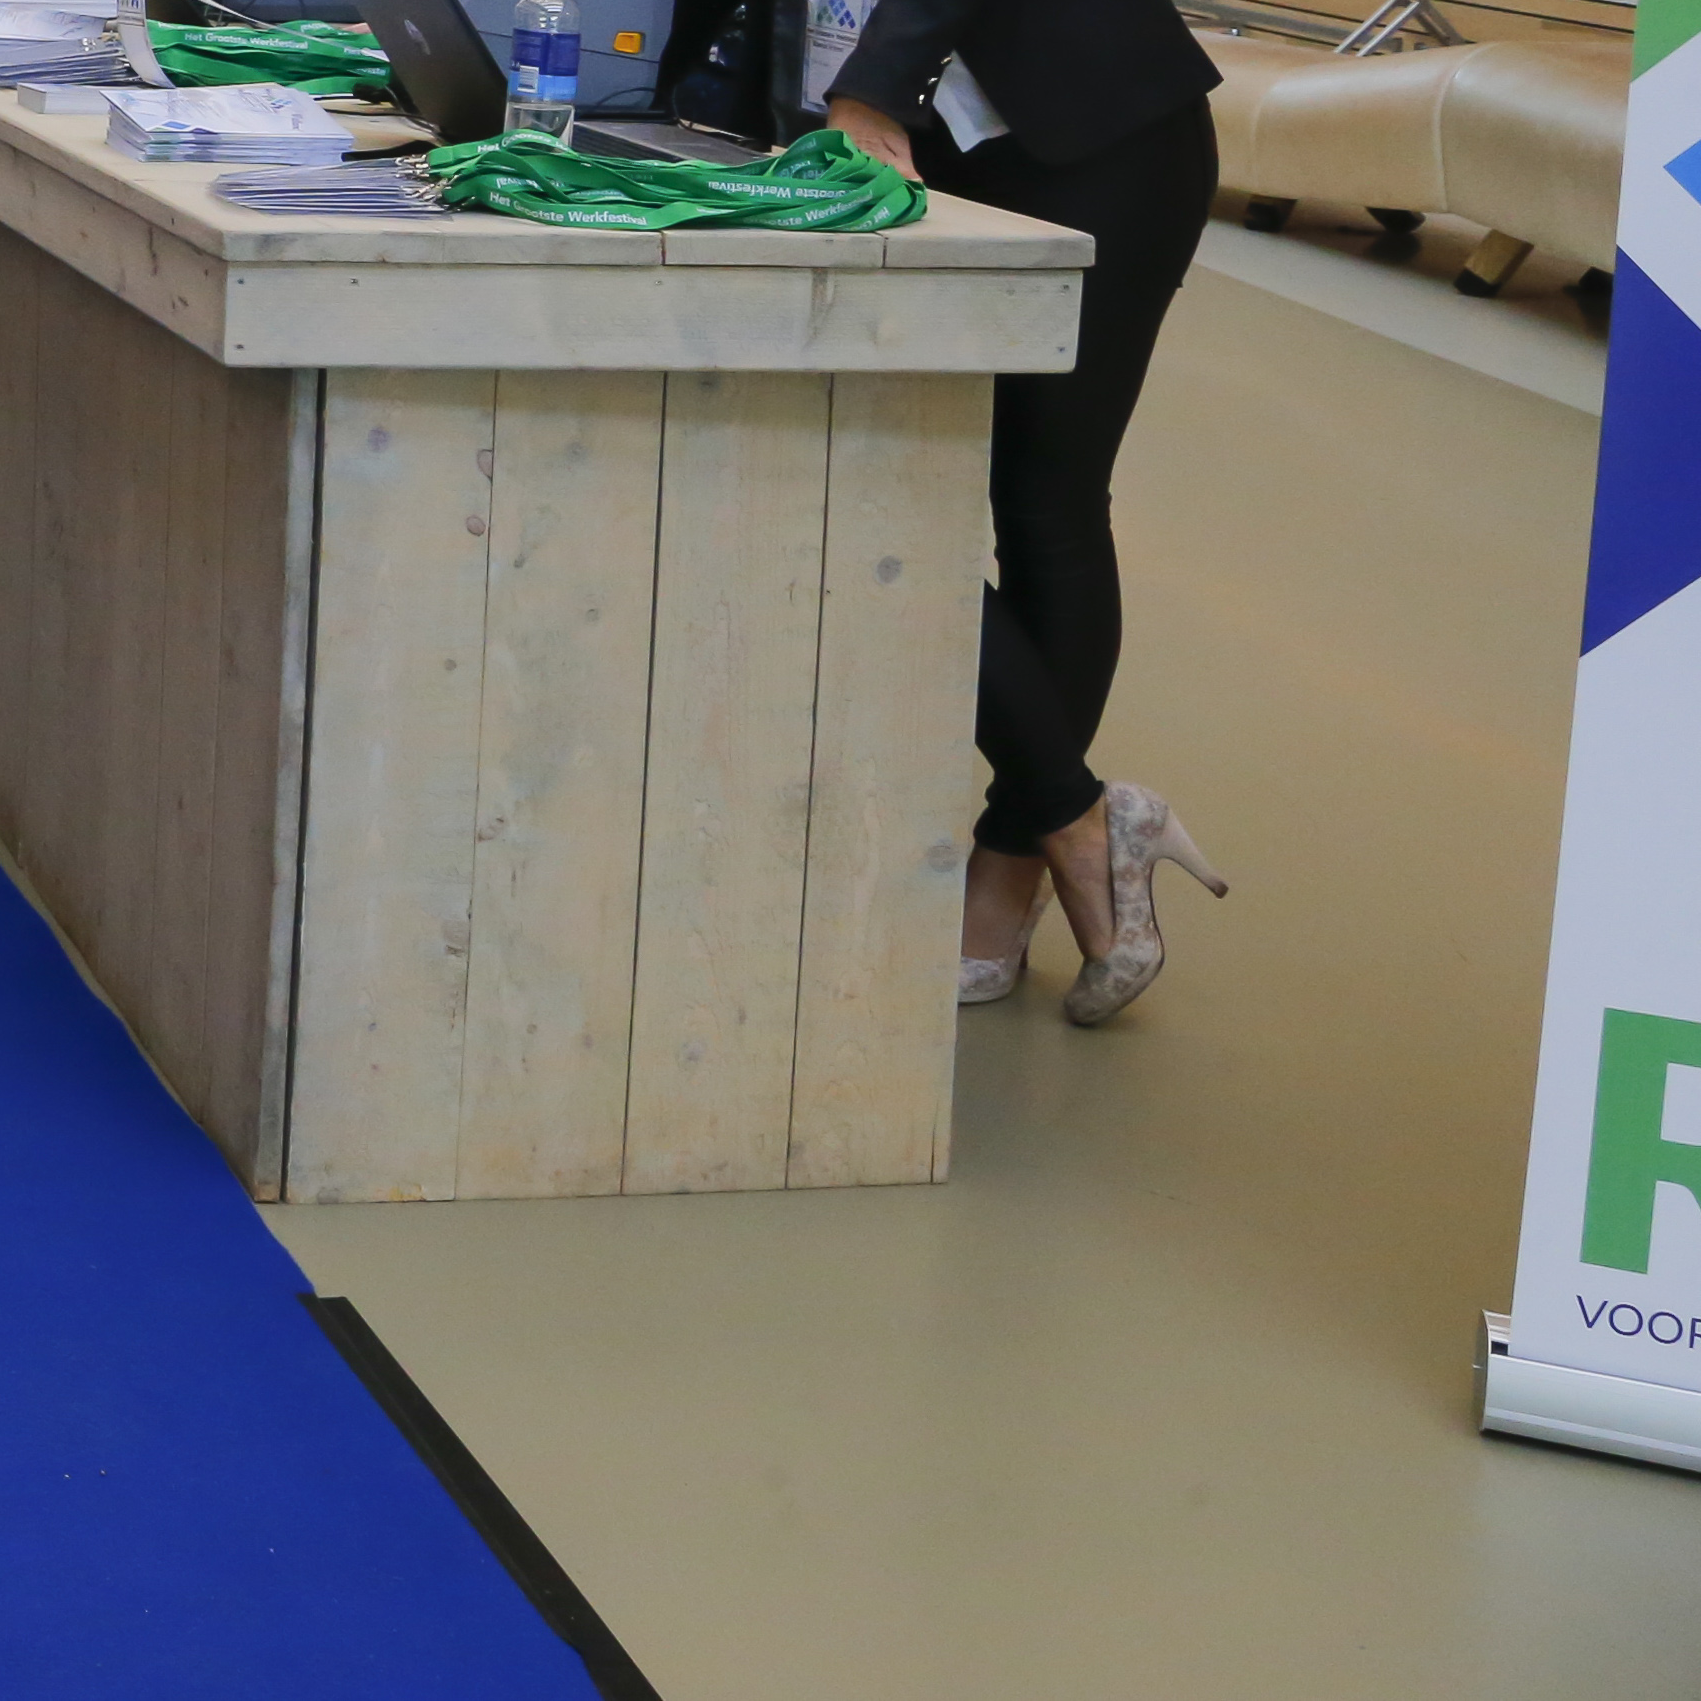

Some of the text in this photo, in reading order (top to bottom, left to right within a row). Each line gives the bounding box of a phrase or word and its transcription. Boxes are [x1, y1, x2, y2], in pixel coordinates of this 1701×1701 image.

[184, 32, 203, 41] Het
[249, 37, 309, 50] Werkfestival
[489, 191, 648, 227] Het Grootste Werkfestival
